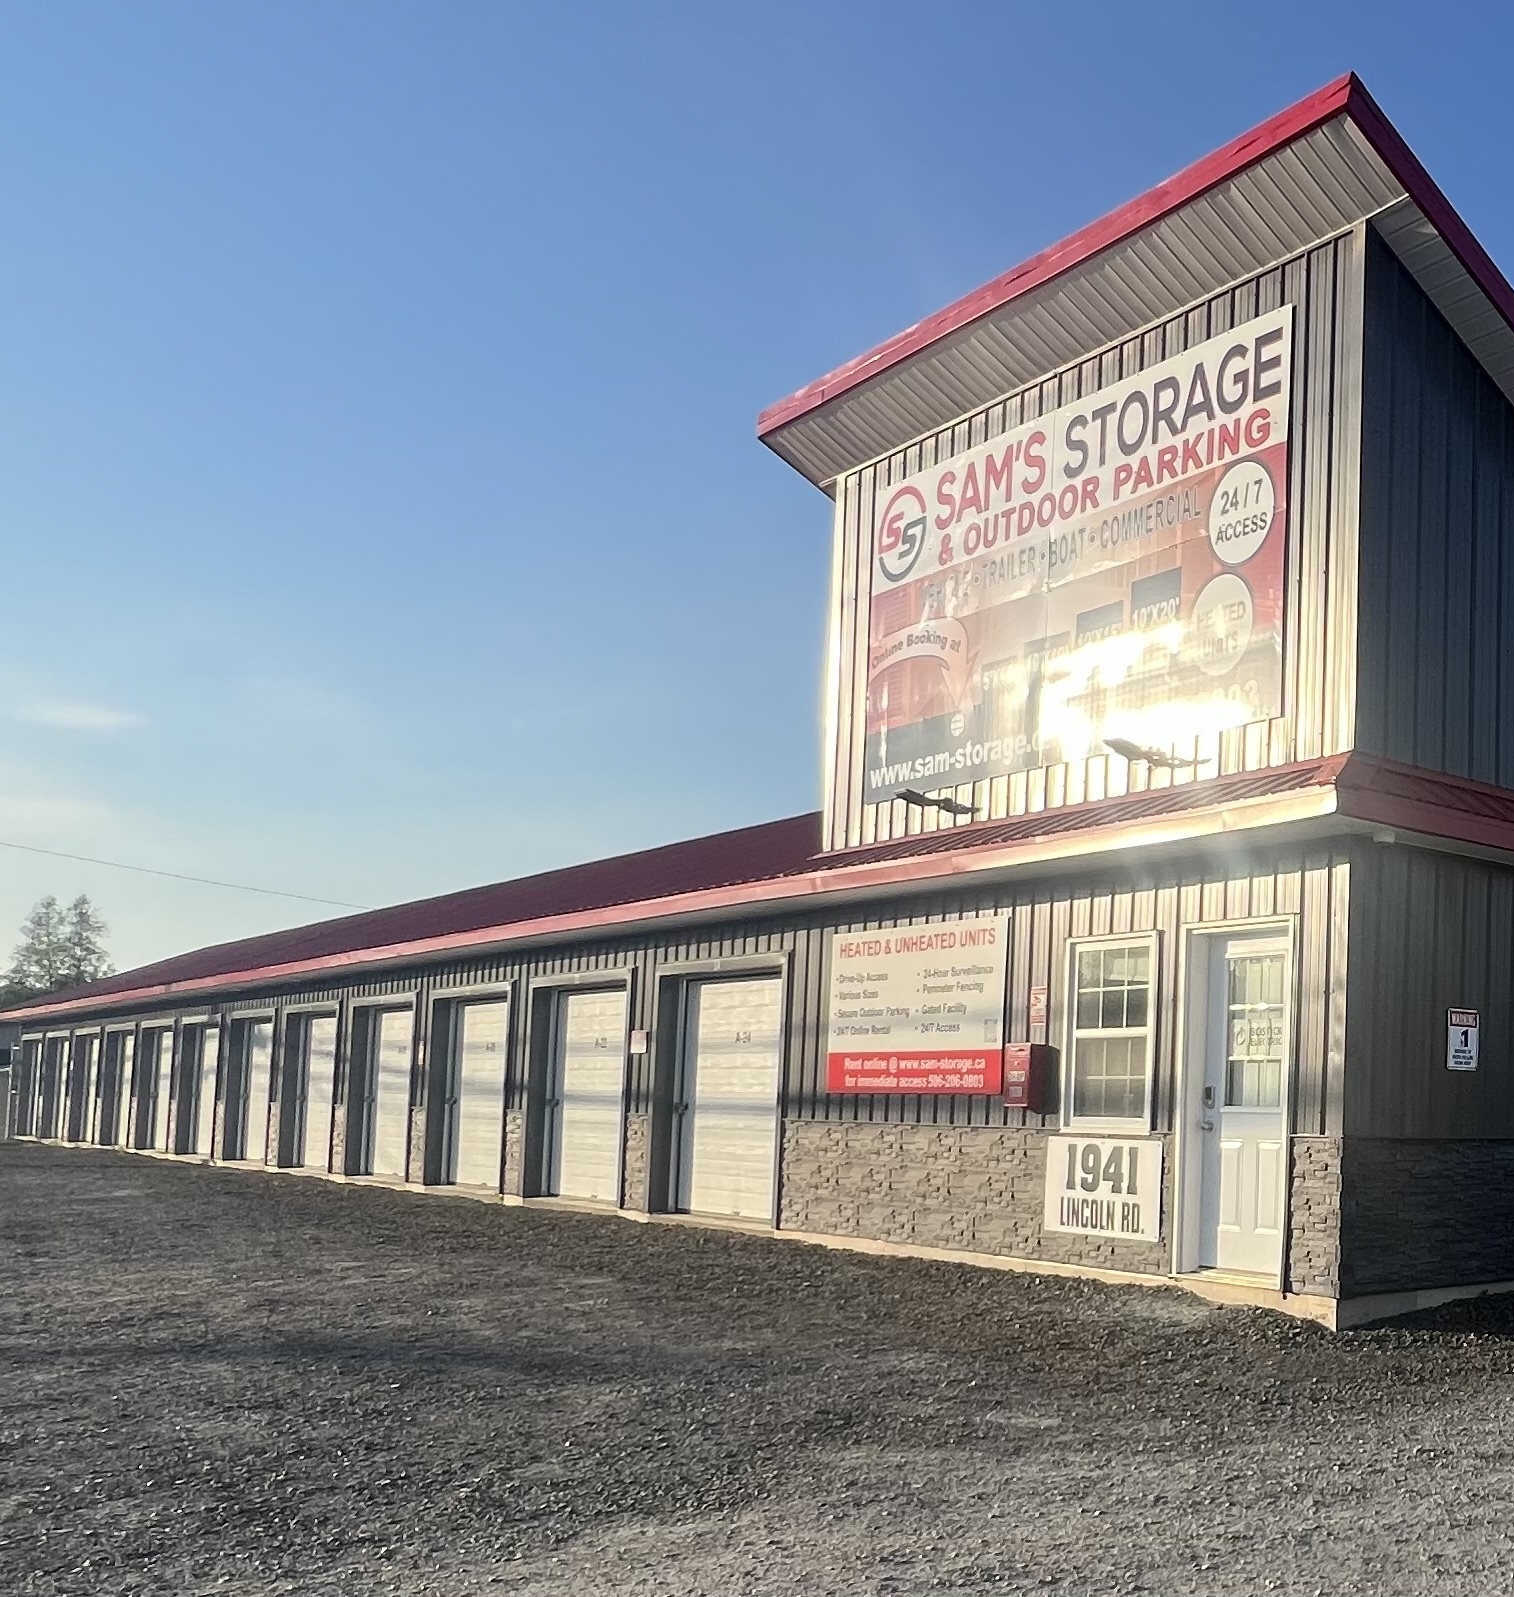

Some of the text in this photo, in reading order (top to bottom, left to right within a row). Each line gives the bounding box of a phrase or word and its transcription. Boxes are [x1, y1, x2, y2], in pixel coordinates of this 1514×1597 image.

[935, 326, 1284, 531] SAM'S STORAGE
[938, 408, 1271, 567] & OUTDOOR PARKING
[982, 546, 1036, 589] TRAILER
[1049, 527, 1086, 568] BOAT
[1099, 490, 1201, 549] COMMERCIAL
[1215, 511, 1268, 545] ACCESS
[906, 629, 948, 651] Booking
[869, 729, 1042, 789] www.sam-storage.c
[839, 927, 996, 959] HEATED & UNHEATED UNITS
[844, 1056, 986, 1073] Rent online @ www.sam-storage.ca
[844, 1074, 857, 1087] for
[857, 1074, 898, 1087] immediate
[899, 1077, 928, 1088] access
[1066, 1143, 1139, 1196] 1941
[1059, 1196, 1145, 1235] LINCOLN RD.
